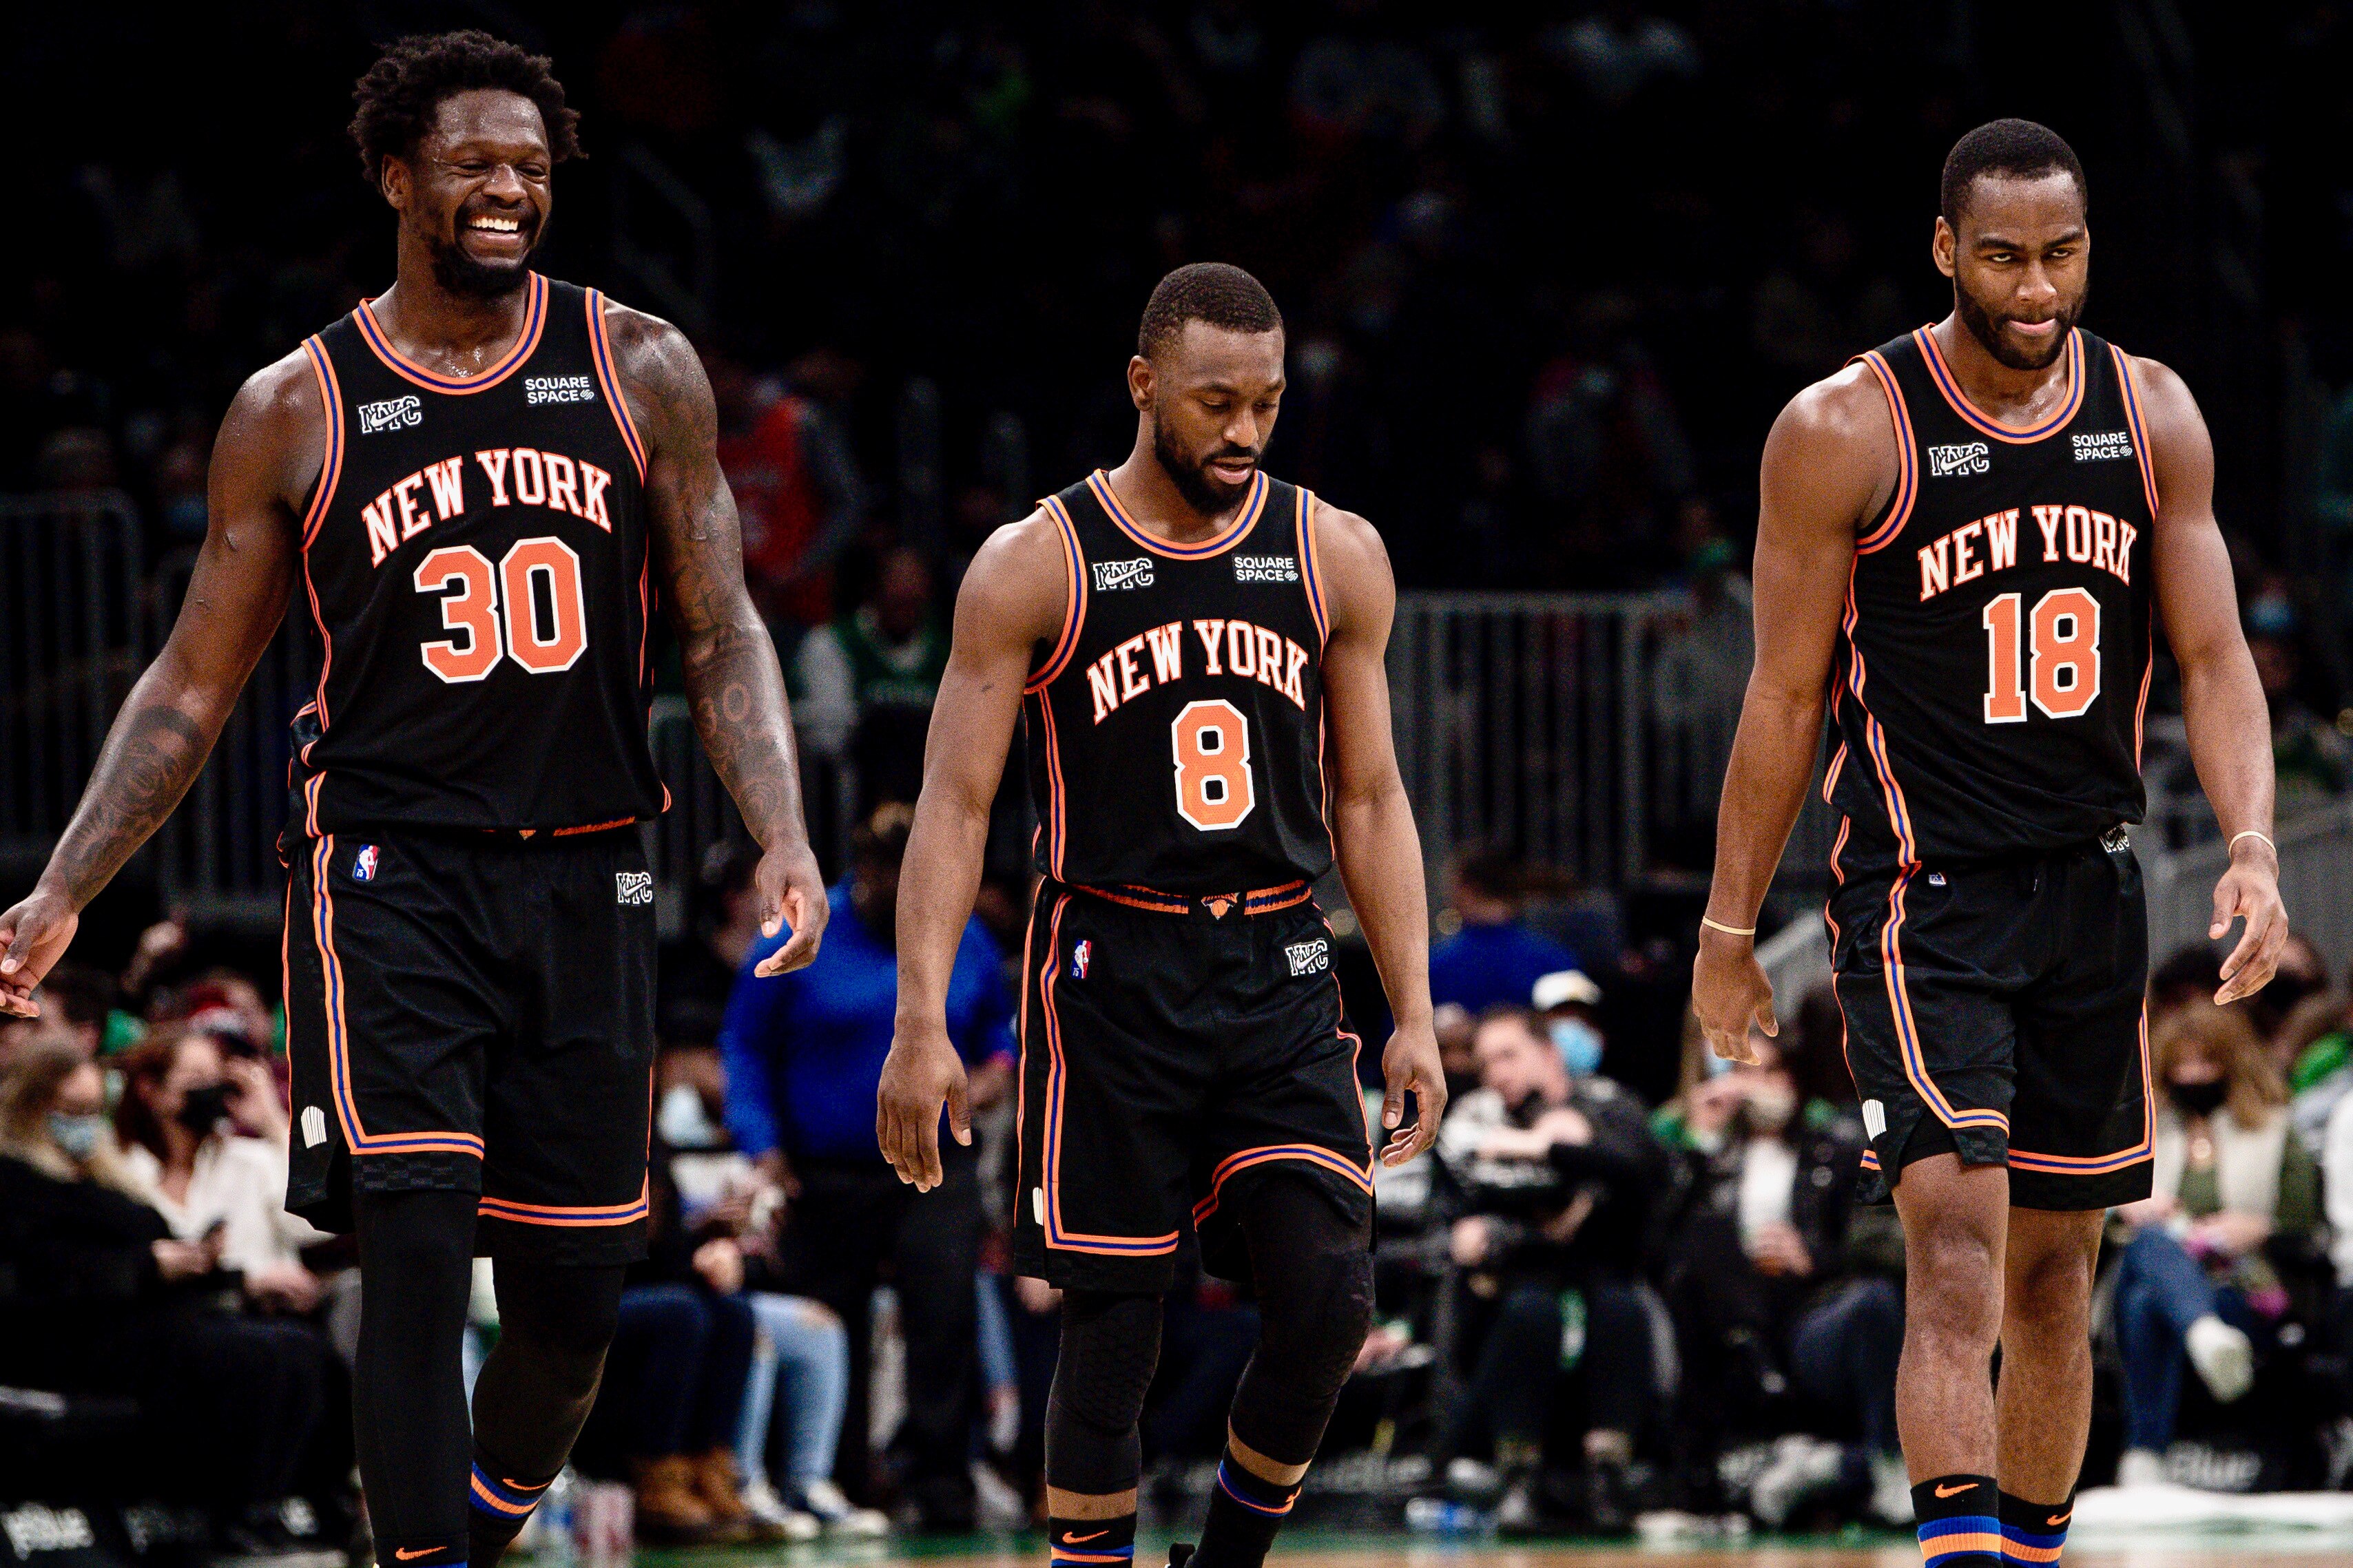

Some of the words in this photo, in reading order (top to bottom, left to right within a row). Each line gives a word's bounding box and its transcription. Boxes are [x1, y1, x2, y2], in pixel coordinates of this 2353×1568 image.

[525, 377, 590, 390] SQUARE
[528, 390, 580, 404] SPACE
[2072, 432, 2128, 447] SQUARE
[2075, 446, 2119, 460] SPACE
[361, 455, 464, 569] NEW
[475, 448, 612, 533] YORK
[1234, 557, 1294, 569] SQUARE
[1236, 569, 1284, 581] SPACE
[1918, 508, 2020, 602] NEW
[2031, 505, 2137, 586] YORK
[413, 536, 588, 683] 30
[1086, 621, 1182, 726] NEW
[1194, 619, 1308, 711] YORK
[1983, 587, 2100, 724] 18
[1172, 699, 1255, 831] 8
